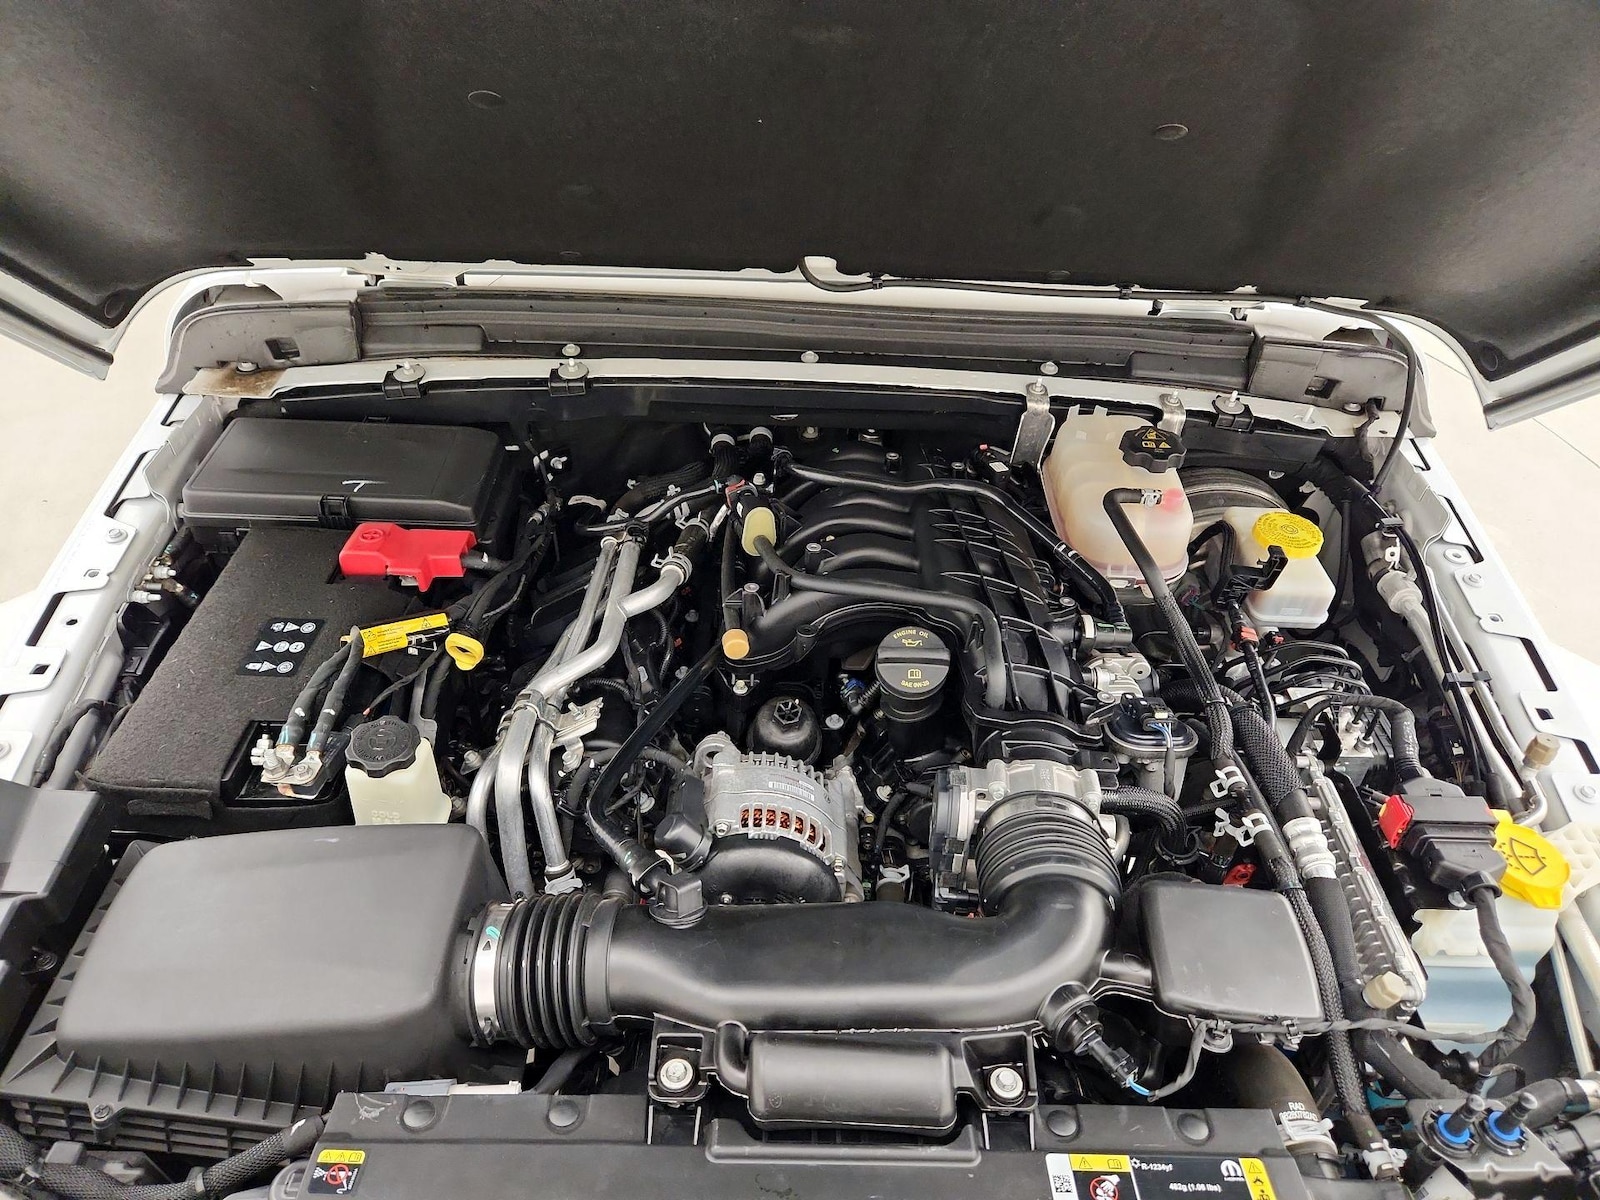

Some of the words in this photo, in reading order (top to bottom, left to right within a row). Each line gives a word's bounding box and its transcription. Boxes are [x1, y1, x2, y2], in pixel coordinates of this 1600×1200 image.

[893, 629, 917, 639] ENGINE
[919, 630, 930, 639] OIL
[1288, 1102, 1305, 1111] RAD
